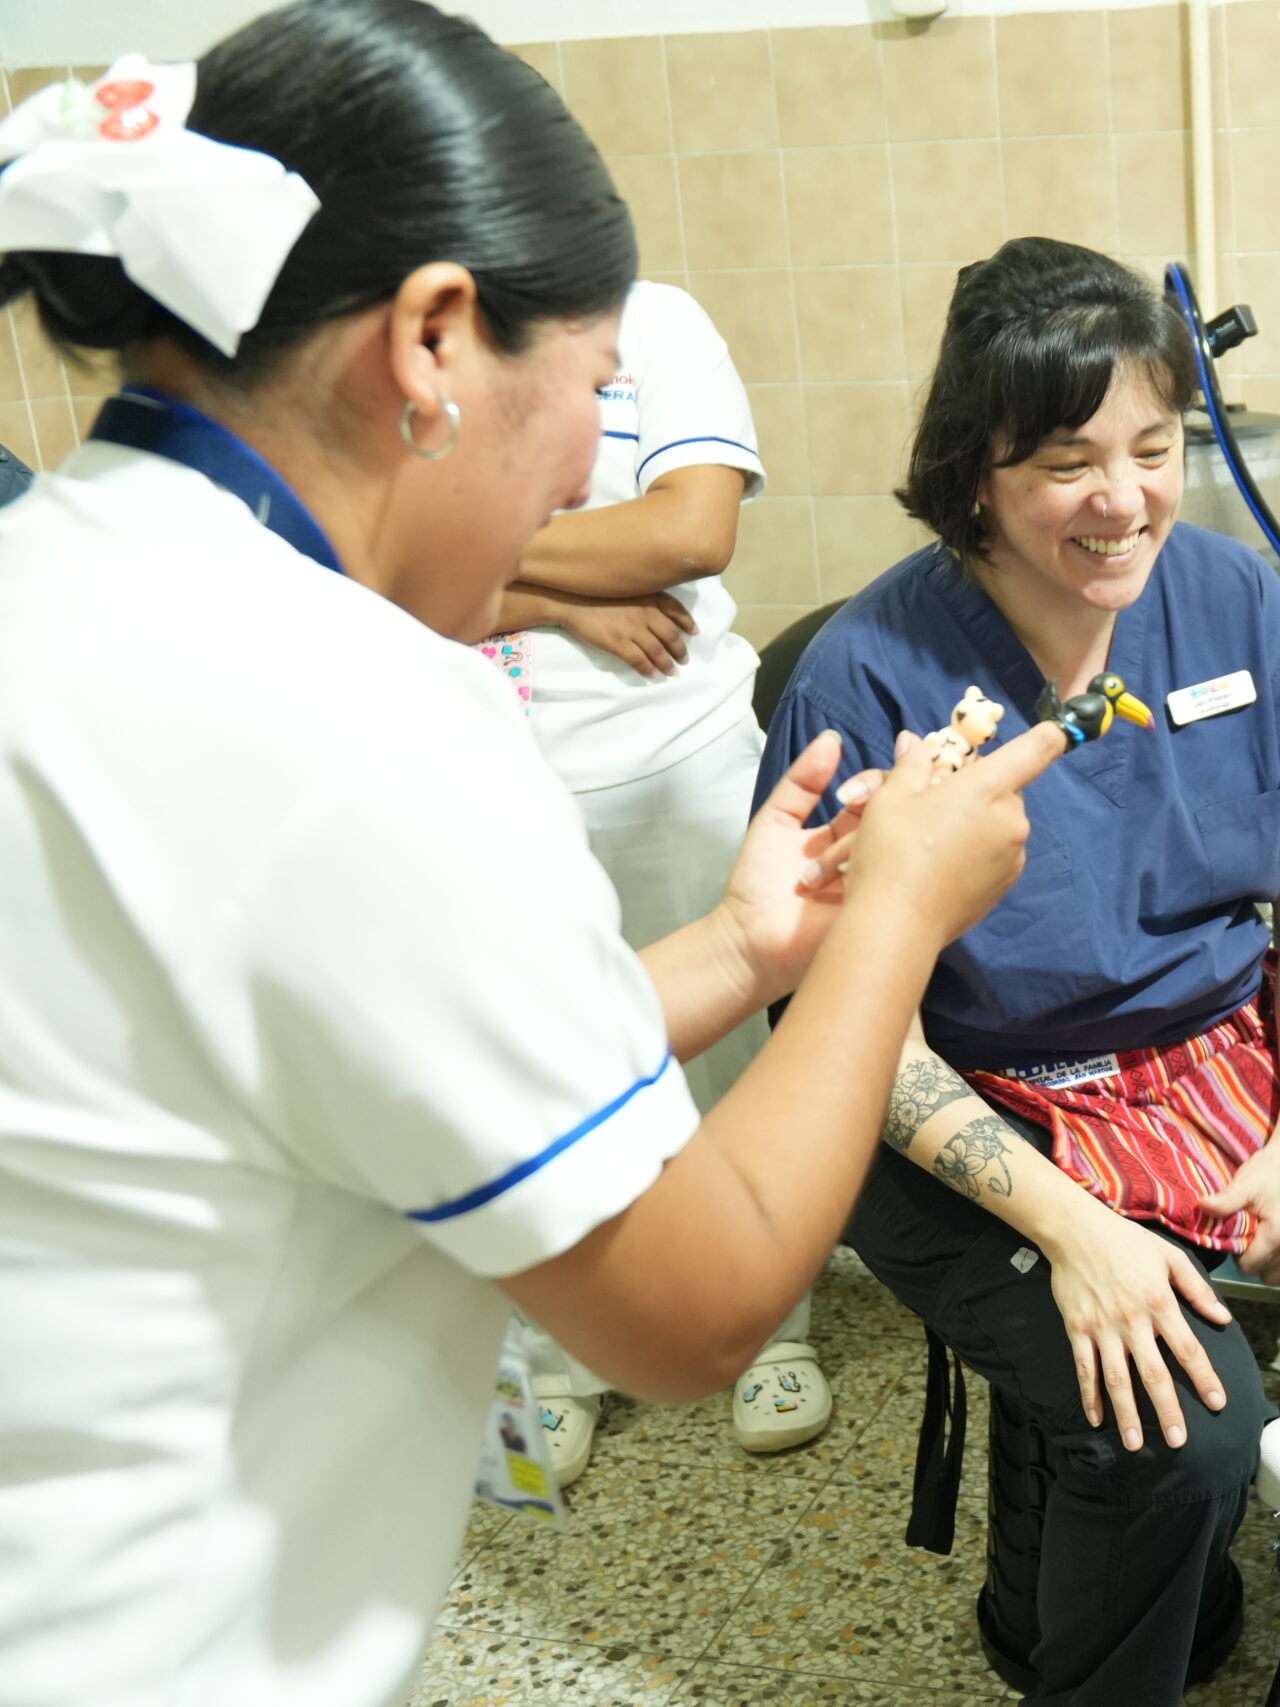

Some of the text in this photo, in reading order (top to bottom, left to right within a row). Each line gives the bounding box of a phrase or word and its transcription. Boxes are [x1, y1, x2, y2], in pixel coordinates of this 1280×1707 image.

[1056, 1071, 1067, 1079] DE
[1070, 1067, 1080, 1075] LA
[1084, 1060, 1112, 1071] FAMILIA
